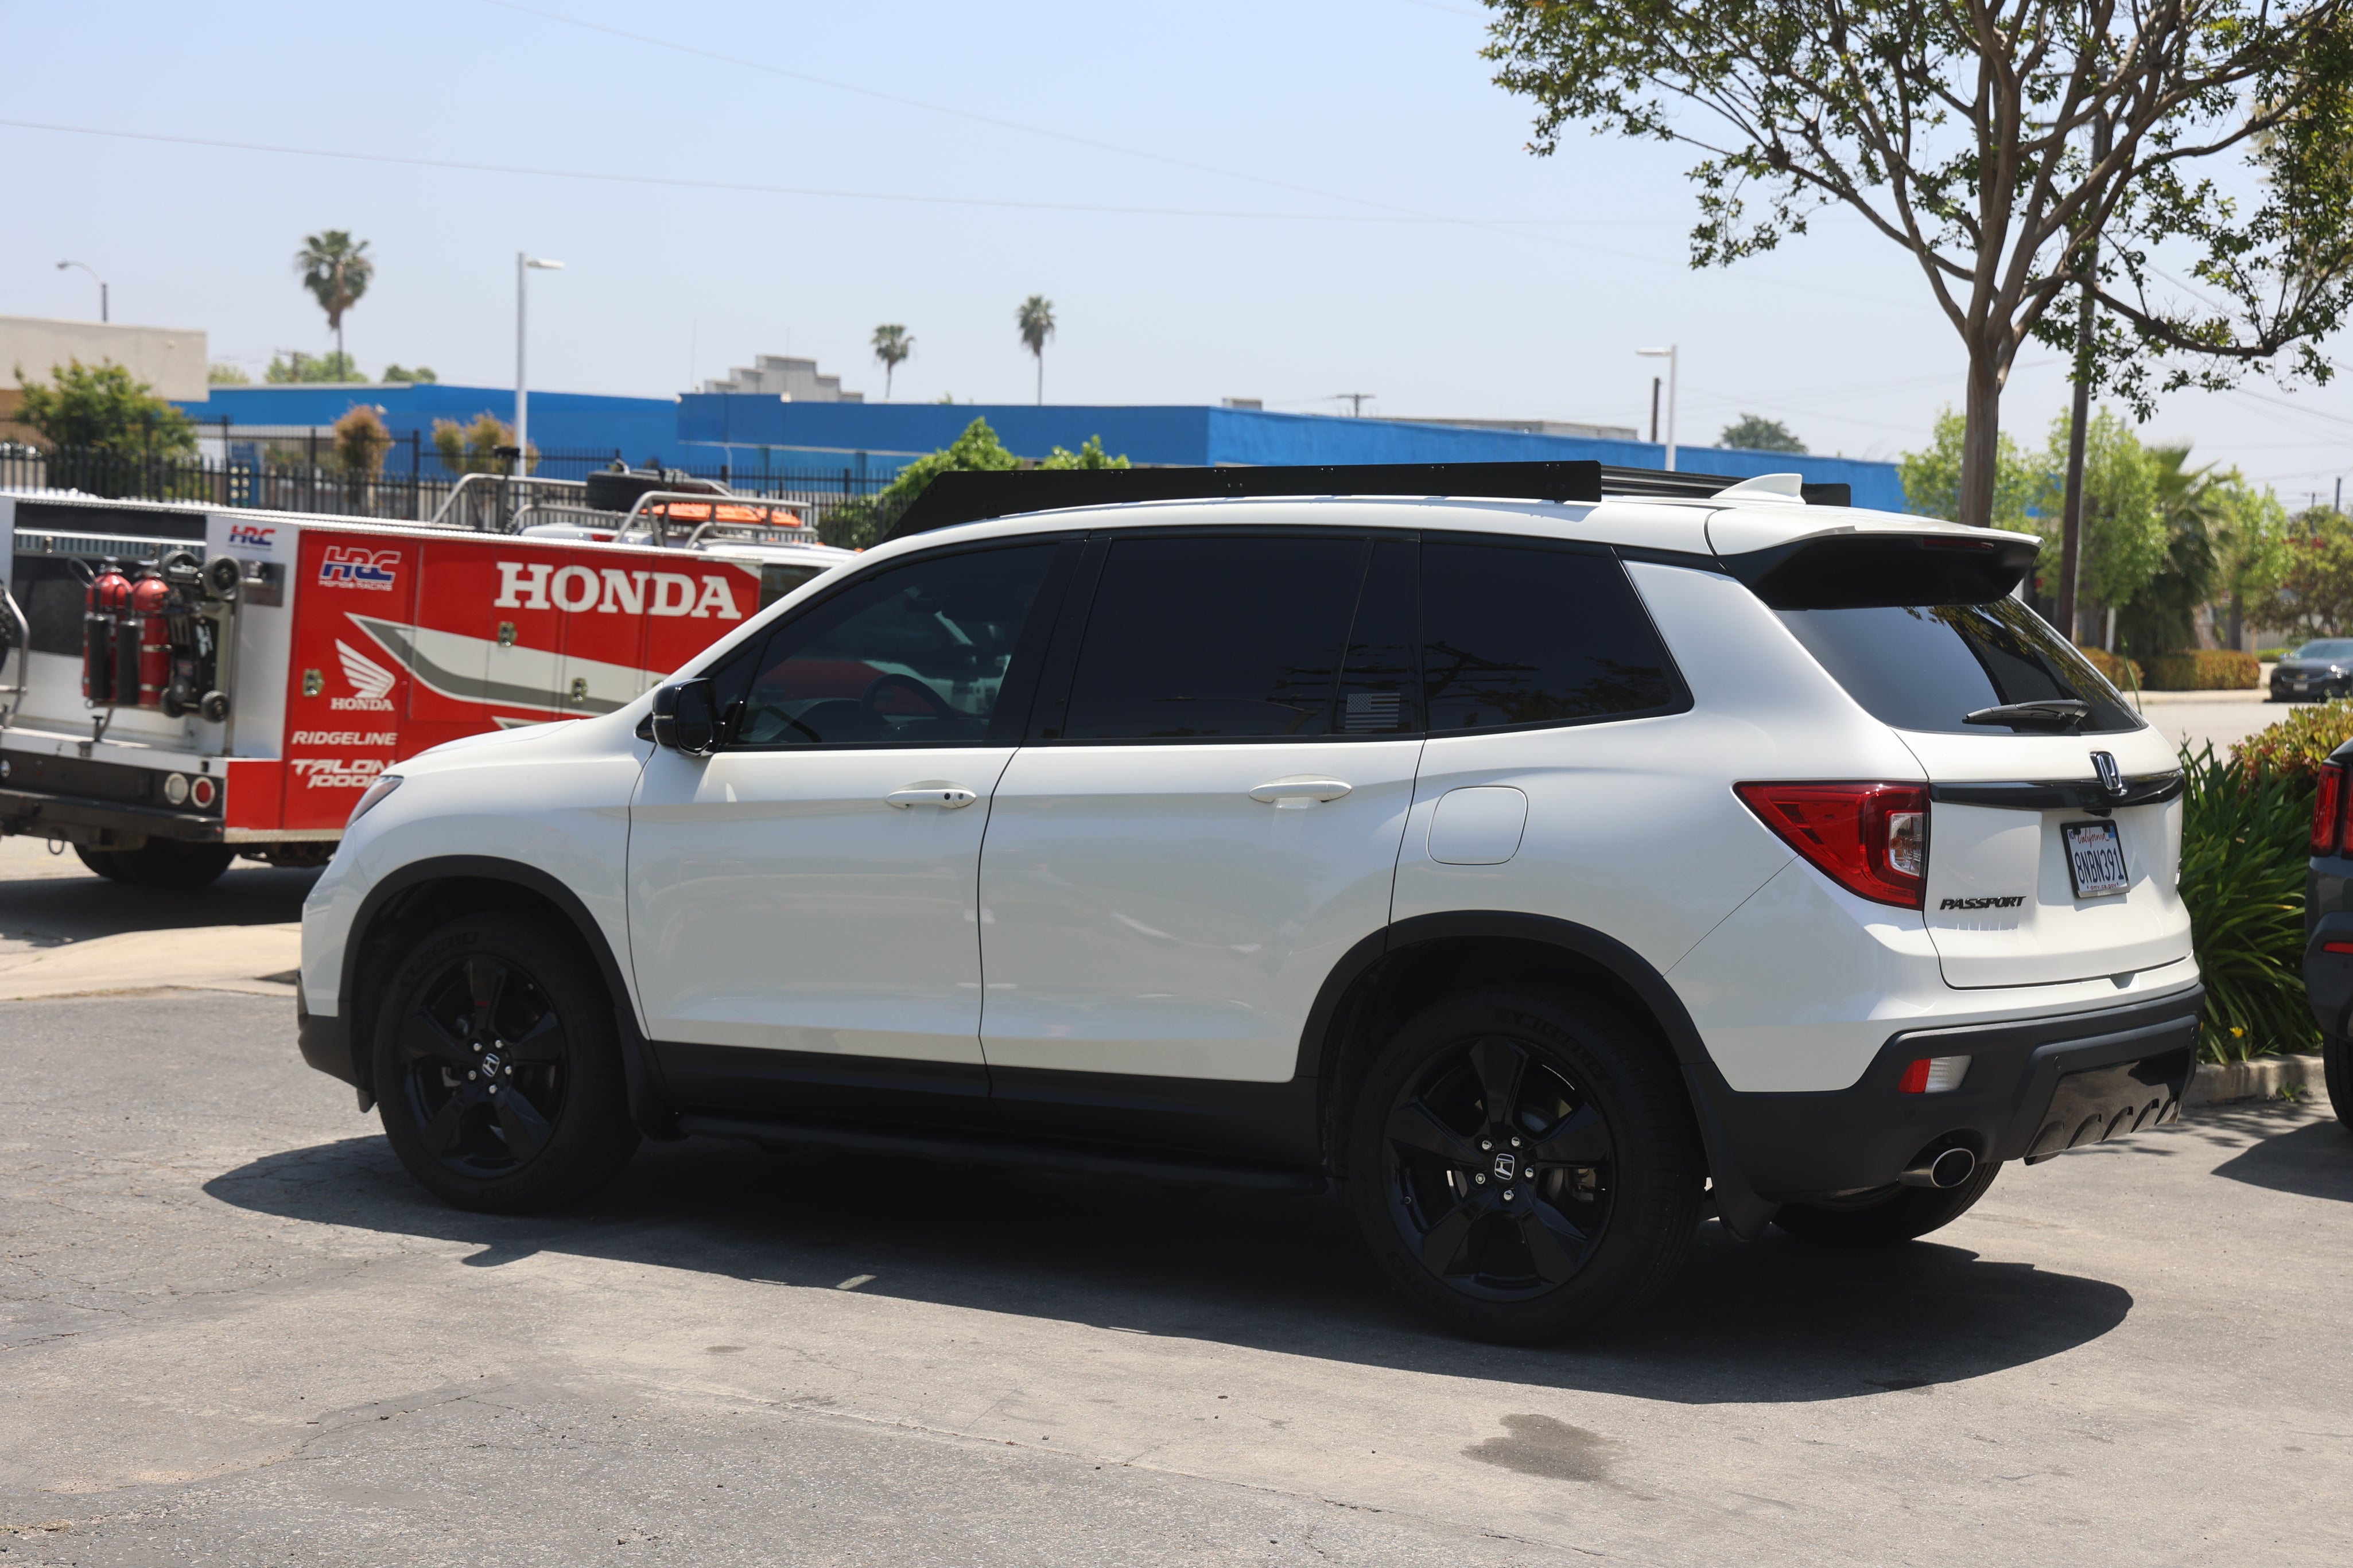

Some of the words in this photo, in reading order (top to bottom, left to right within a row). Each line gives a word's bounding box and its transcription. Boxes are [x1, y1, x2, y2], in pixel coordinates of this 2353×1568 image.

[229, 524, 277, 546] HRC
[319, 546, 401, 583] HRC
[494, 561, 742, 620] HONDA
[330, 697, 395, 711] HONDA
[292, 730, 398, 745] RIDGELINE
[2078, 827, 2110, 849] California
[2075, 847, 2124, 884] 8NBN391
[1940, 896, 2027, 910] PASSPORT
